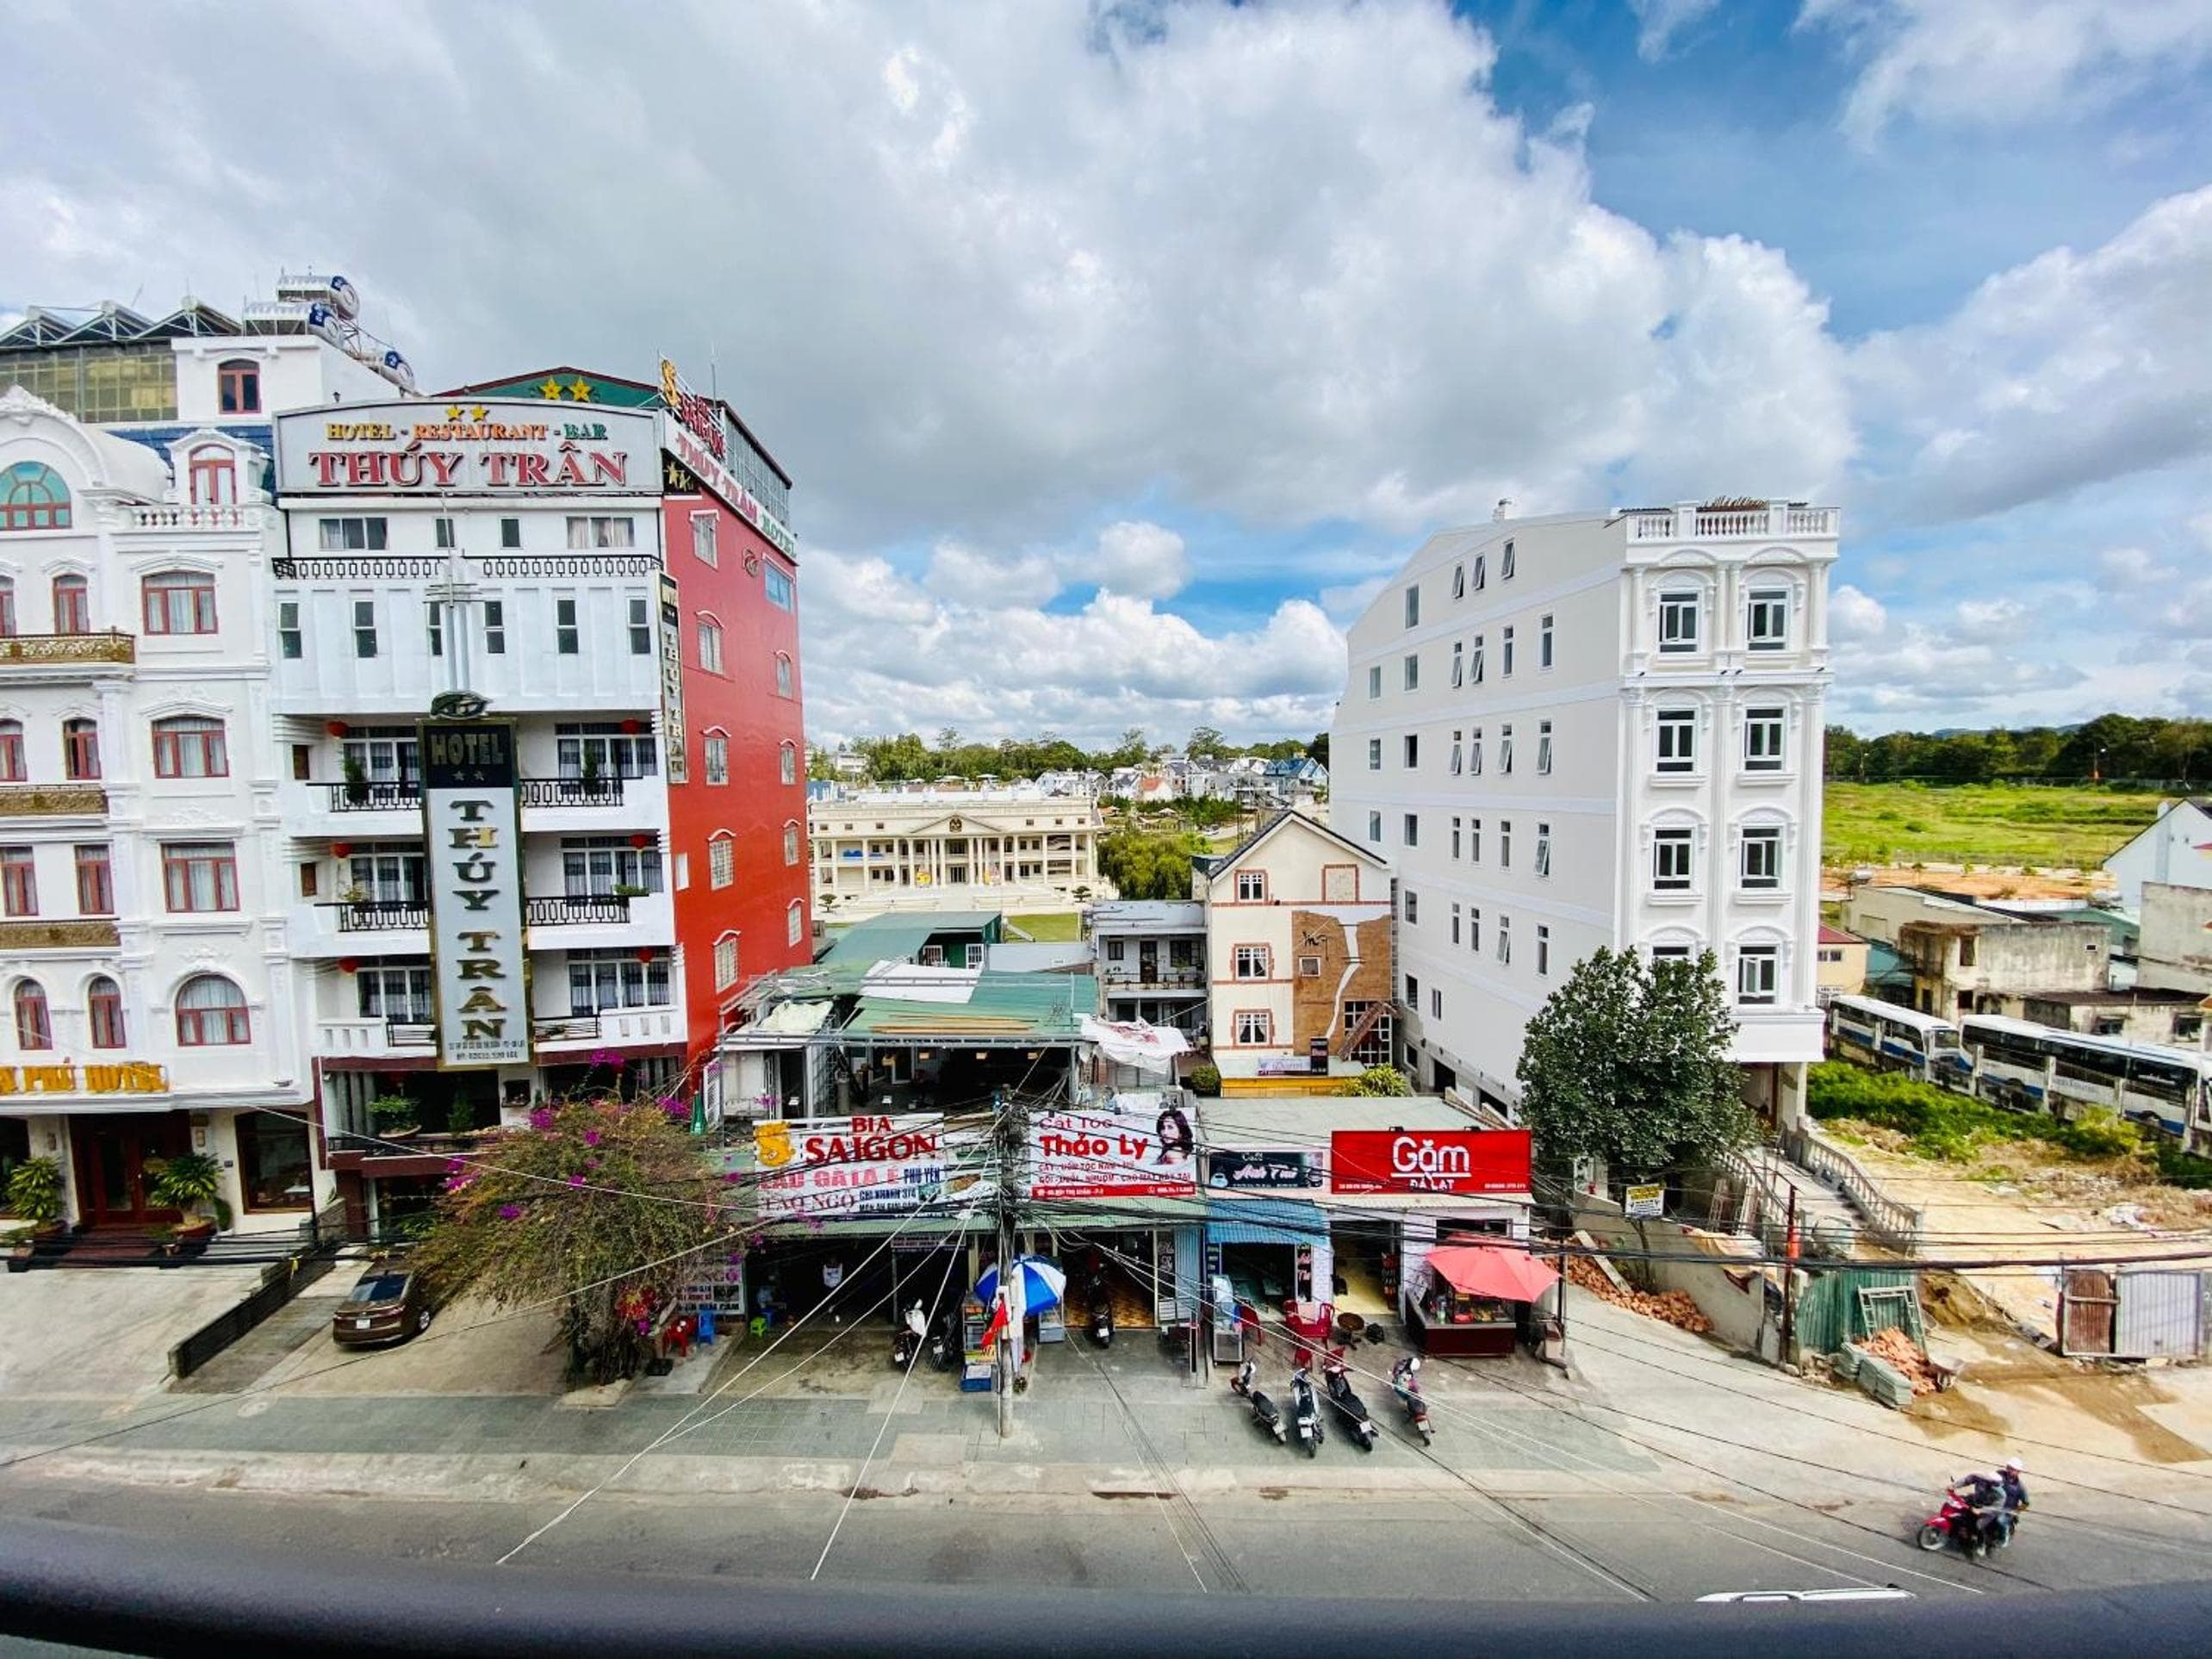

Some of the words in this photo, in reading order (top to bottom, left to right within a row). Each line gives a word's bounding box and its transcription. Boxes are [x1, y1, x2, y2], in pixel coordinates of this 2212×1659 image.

[326, 423, 395, 442] HOTEL
[413, 422, 550, 442] RESTAURANT
[563, 423, 607, 441] BAR
[308, 441, 463, 488] THÚY
[479, 441, 628, 488] TRÂN
[431, 733, 504, 766] HOTEL
[447, 799, 500, 911] THÚY
[456, 930, 508, 1041] TRÂN
[851, 1115, 892, 1133] BIA
[805, 1133, 937, 1165] SAIGON
[1039, 1131, 1109, 1157] Thảo
[1119, 1133, 1148, 1159] Ly
